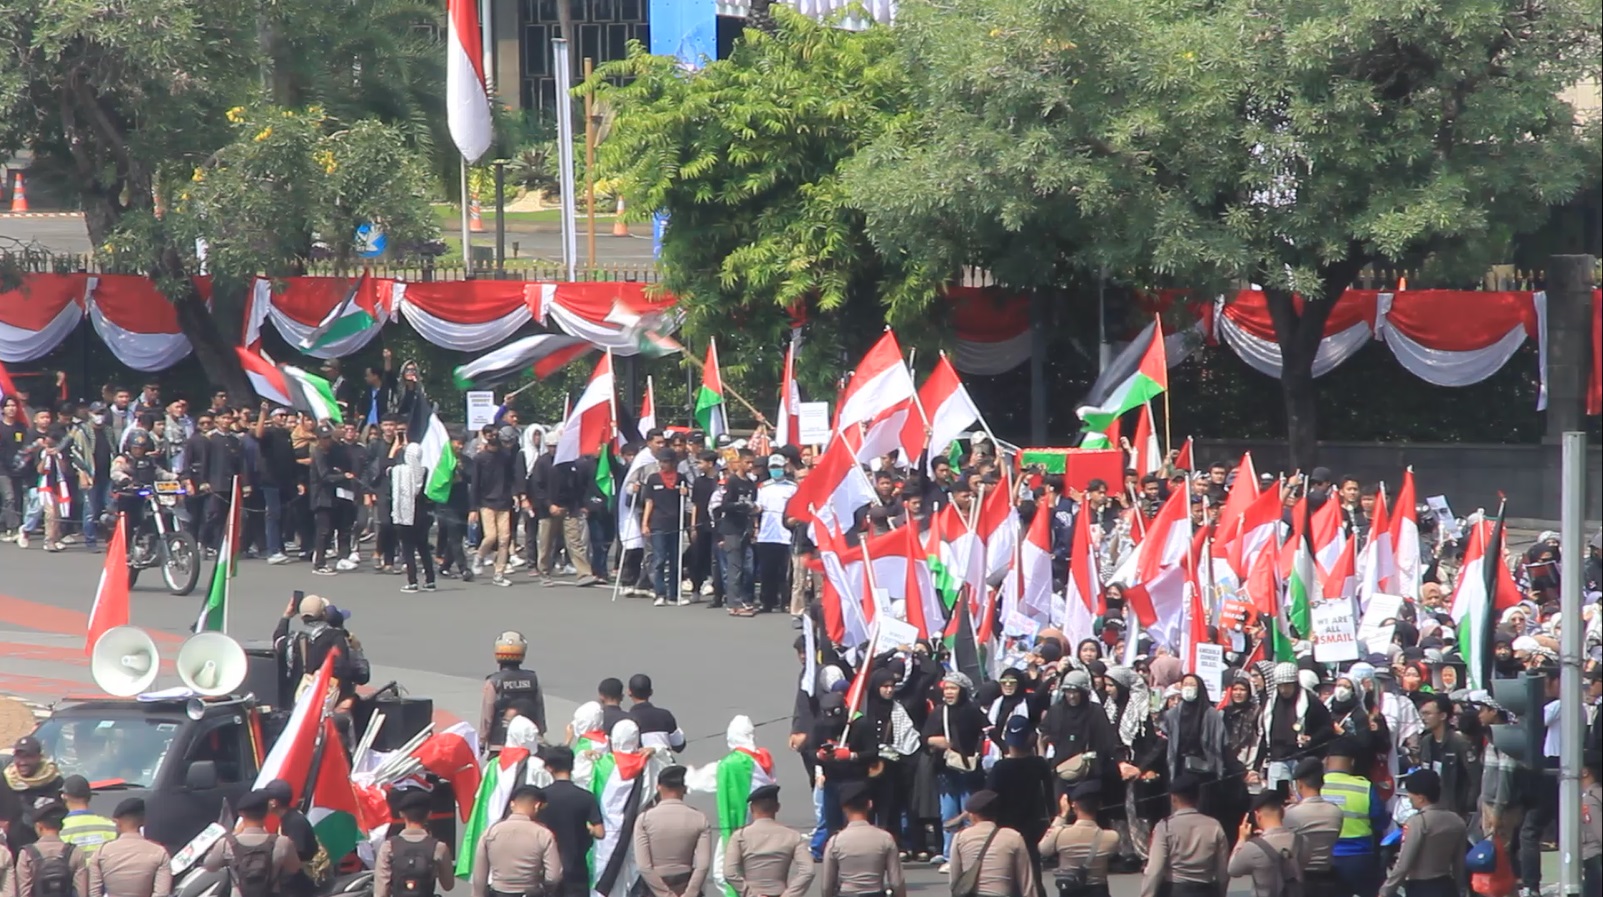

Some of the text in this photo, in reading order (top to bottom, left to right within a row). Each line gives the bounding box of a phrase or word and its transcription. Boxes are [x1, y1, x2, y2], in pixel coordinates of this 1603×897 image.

[1331, 615, 1348, 624] ARE
[1325, 625, 1341, 633] ALL
[503, 680, 530, 689] POLISI
